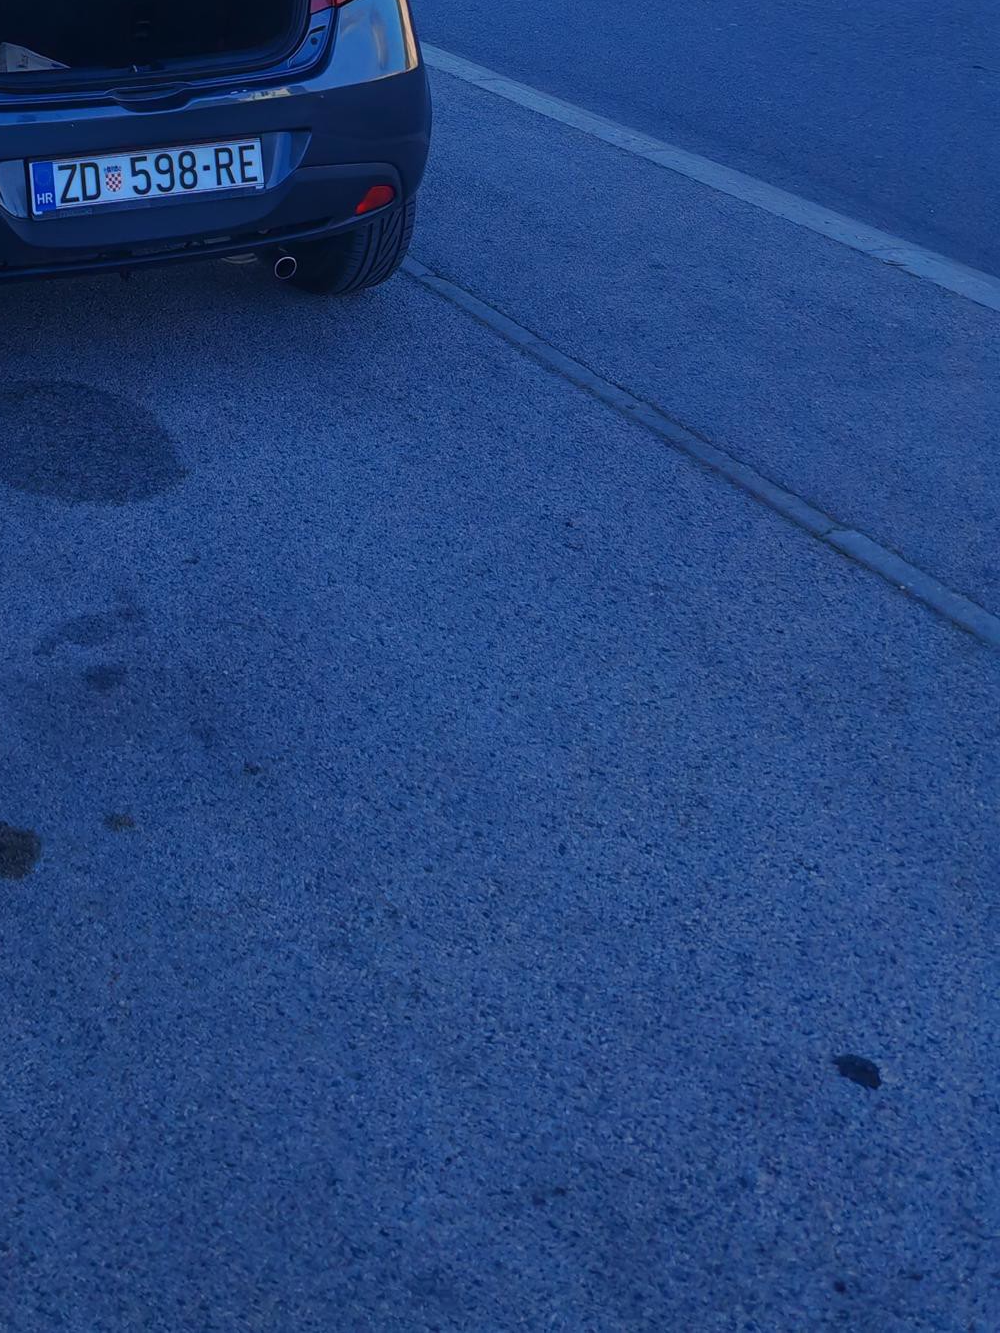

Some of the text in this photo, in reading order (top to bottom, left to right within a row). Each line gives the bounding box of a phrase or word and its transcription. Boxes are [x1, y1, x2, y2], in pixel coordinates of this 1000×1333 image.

[57, 144, 258, 204] ZD 598-RE
[37, 192, 54, 205] HR
